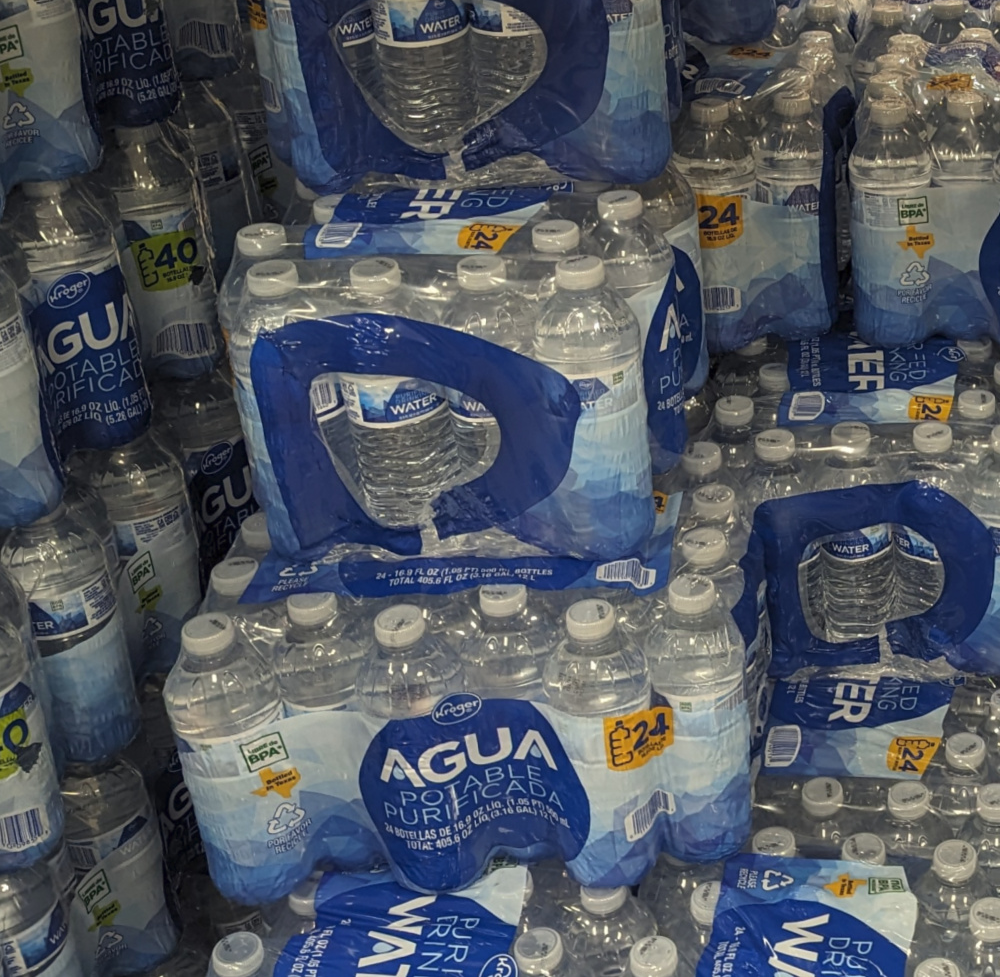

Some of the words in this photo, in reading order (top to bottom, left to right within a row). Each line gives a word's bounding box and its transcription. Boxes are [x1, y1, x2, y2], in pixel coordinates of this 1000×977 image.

[419, 14, 461, 35] WATER
[698, 202, 739, 229] 24
[154, 236, 198, 269] 40
[49, 279, 88, 303] Kroger
[390, 392, 438, 416] WATER
[831, 543, 869, 555] WATER
[632, 712, 670, 747] 24
[380, 727, 558, 788] AGUA
[266, 770, 293, 785] Bottled
[275, 776, 296, 787] Texas
[400, 764, 543, 806] POTABLE
[384, 778, 564, 826] PURIFICADA
